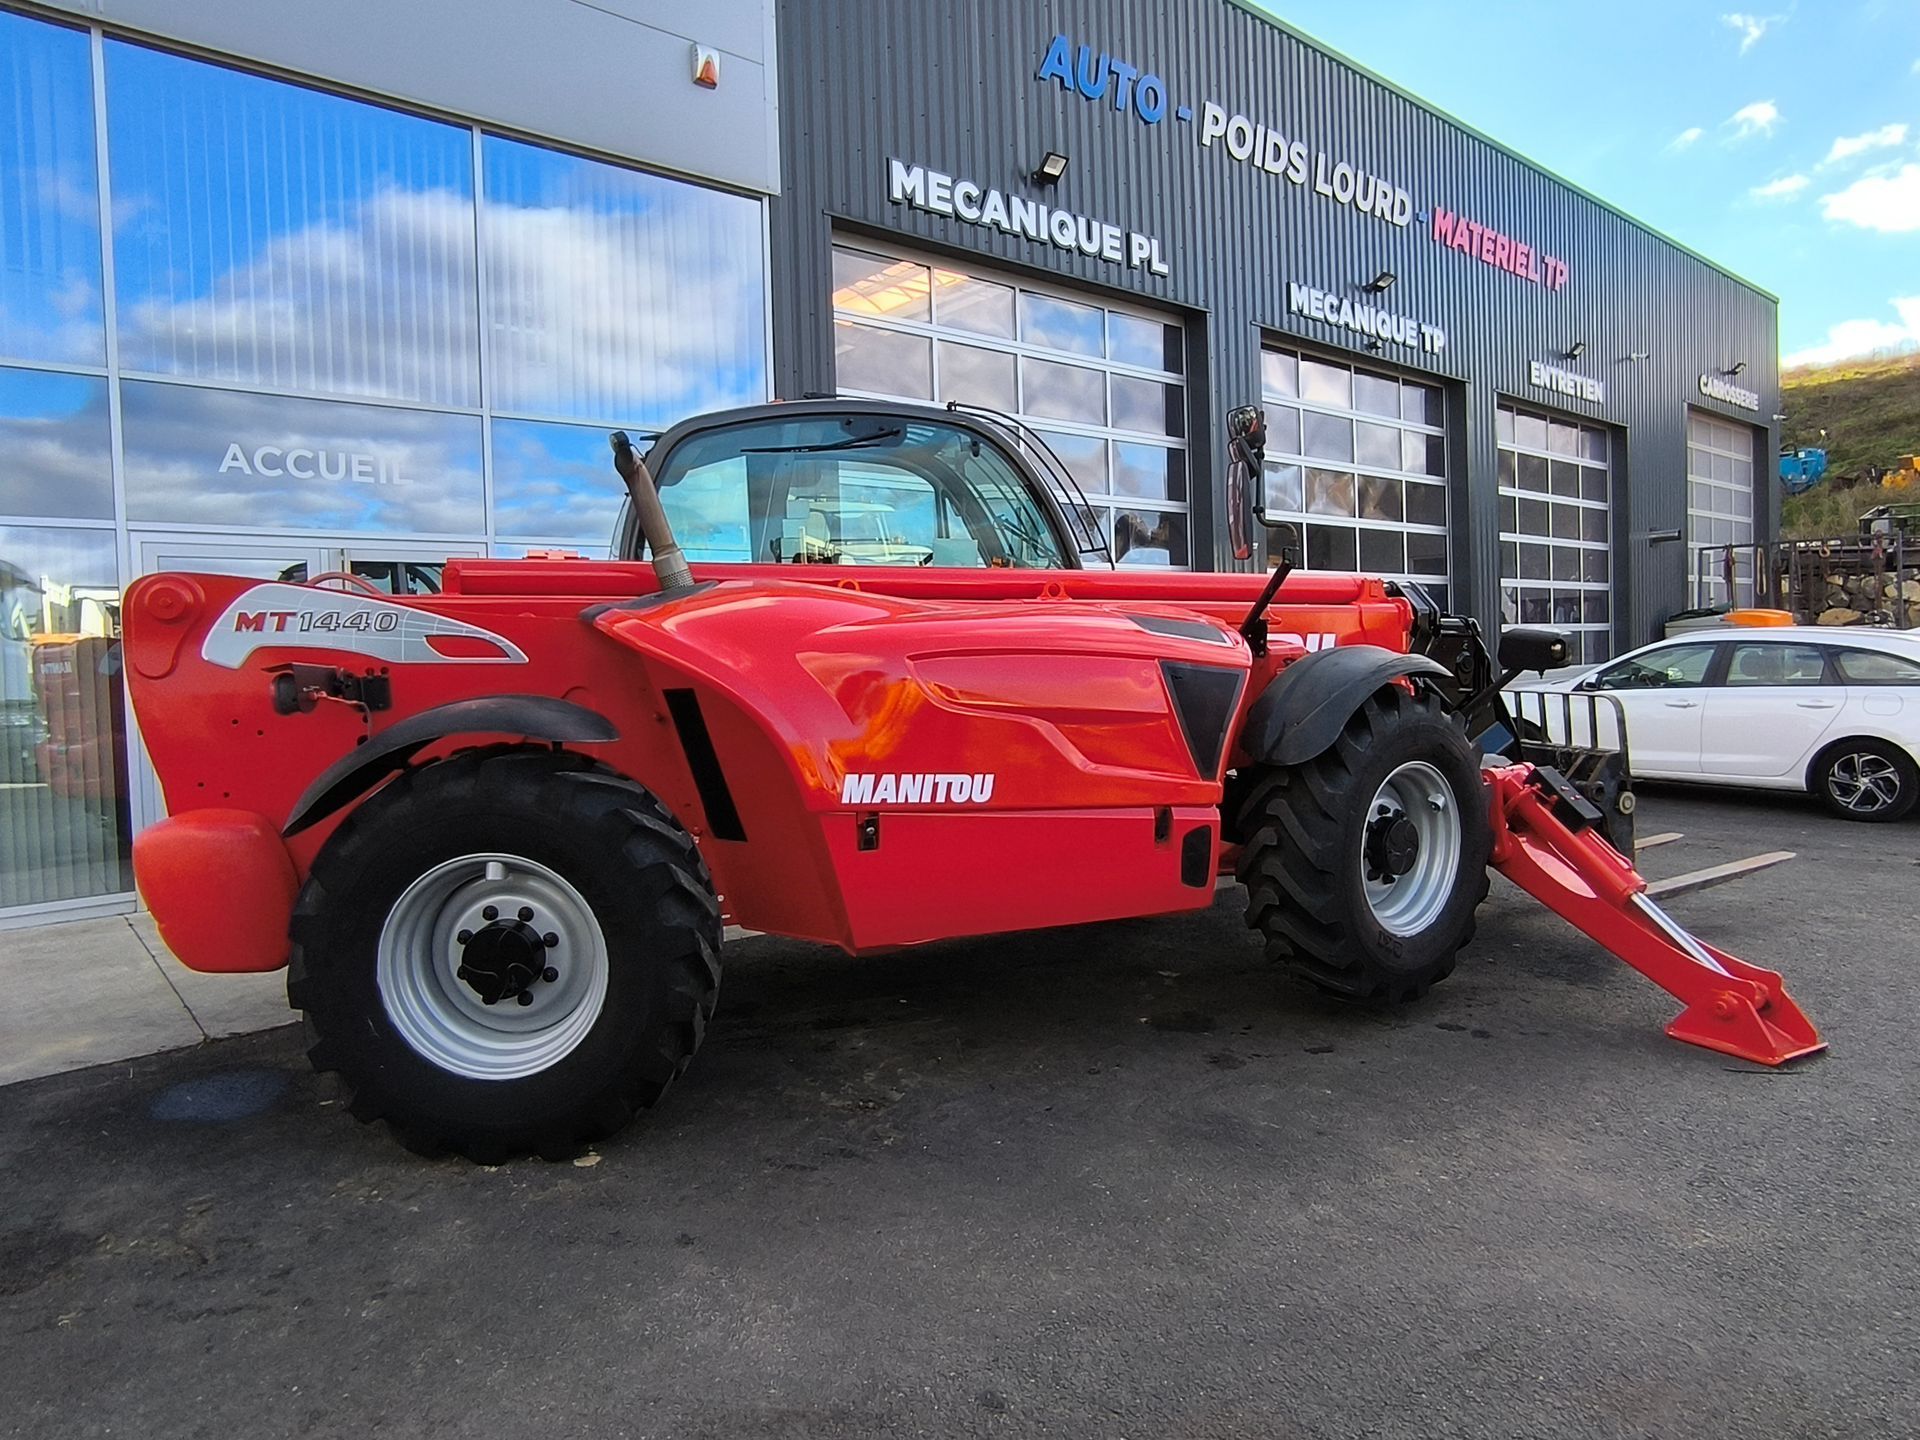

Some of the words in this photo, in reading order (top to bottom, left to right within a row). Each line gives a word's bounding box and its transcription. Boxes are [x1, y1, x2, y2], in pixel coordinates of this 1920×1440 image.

[1038, 34, 1167, 123] AUTO
[1201, 101, 1309, 184] POIDS
[1314, 152, 1412, 227] LOURD
[1433, 206, 1539, 283] MATERIEL
[1543, 255, 1568, 292] TP
[890, 159, 1122, 262] MECANIQUE
[1130, 231, 1169, 276] PL
[1289, 282, 1418, 349] MECANIQUE
[1420, 322, 1445, 354] TP
[1530, 360, 1603, 403] ENTRETIEN
[218, 443, 414, 484] ACCUEIL
[841, 773, 995, 804] MANITOU
